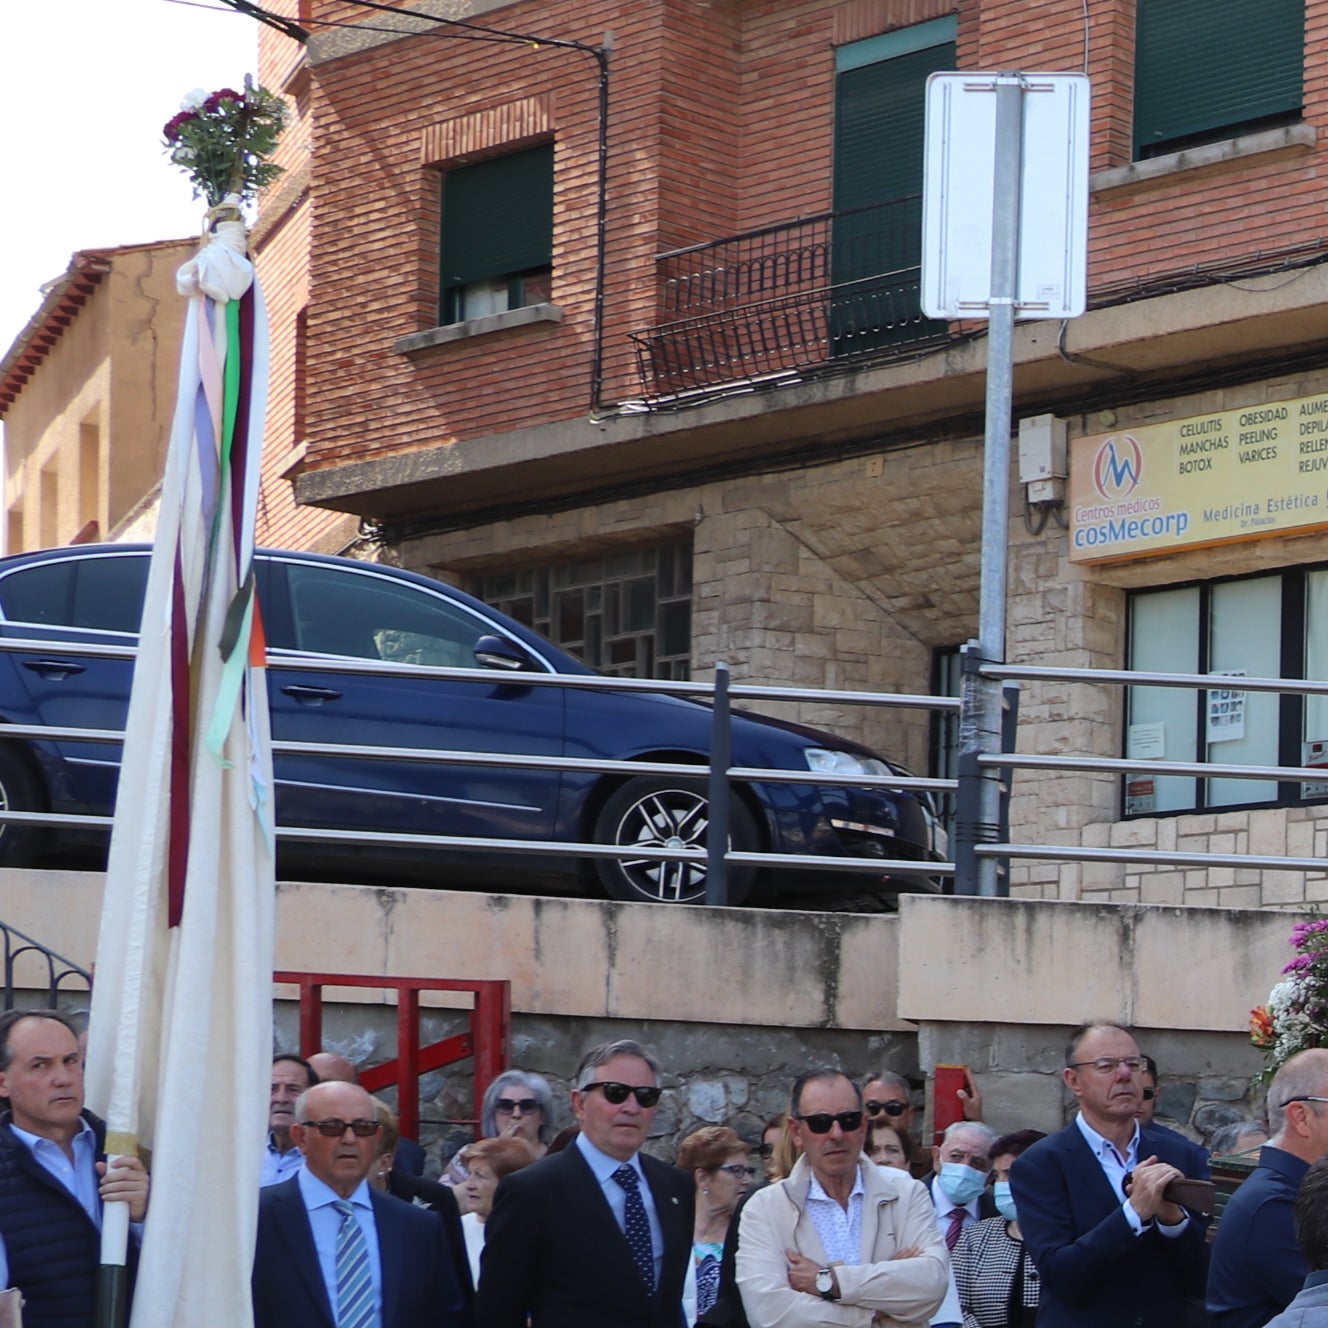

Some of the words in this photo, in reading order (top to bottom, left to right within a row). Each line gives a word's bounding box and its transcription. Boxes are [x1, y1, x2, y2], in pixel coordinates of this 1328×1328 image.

[1238, 407, 1289, 428] OBESIDAD
[1180, 418, 1222, 438] CELULITIS
[1238, 427, 1278, 447] PEELING
[1179, 435, 1229, 456] MANCHAS
[1179, 458, 1213, 475] BOTOX
[1238, 447, 1278, 466] VARICES
[1075, 503, 1115, 523] Centros
[1203, 501, 1260, 524] Medicina
[1266, 493, 1319, 514] Estética
[1074, 510, 1189, 548] cosMecorp
[1251, 516, 1276, 527] Palacios
